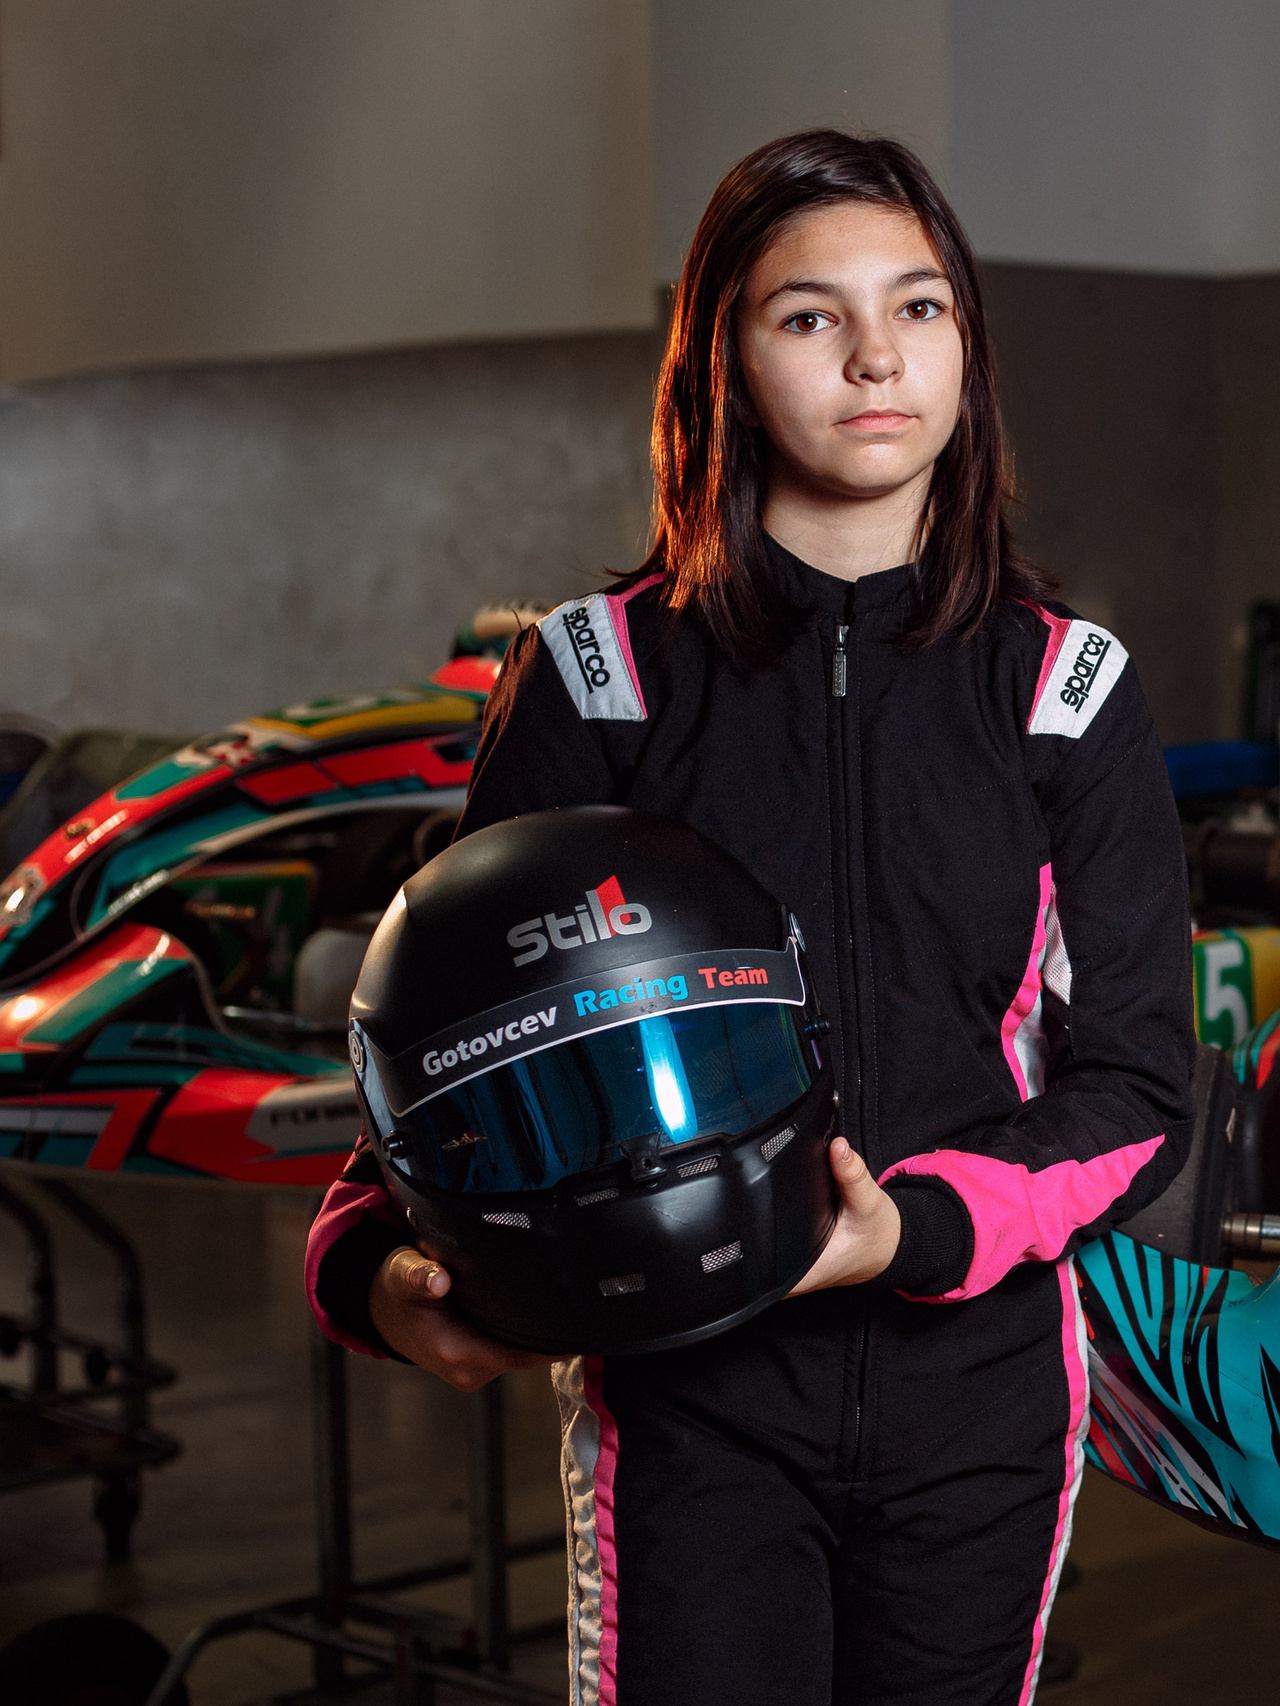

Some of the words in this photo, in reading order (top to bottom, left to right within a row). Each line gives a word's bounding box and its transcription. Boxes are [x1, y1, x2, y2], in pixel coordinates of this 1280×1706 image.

[562, 606, 610, 690] sparco
[1060, 633, 1108, 710] sparco
[423, 1006, 557, 1076] Gotovcev
[573, 975, 689, 1017] Racing
[698, 967, 769, 989] Team
